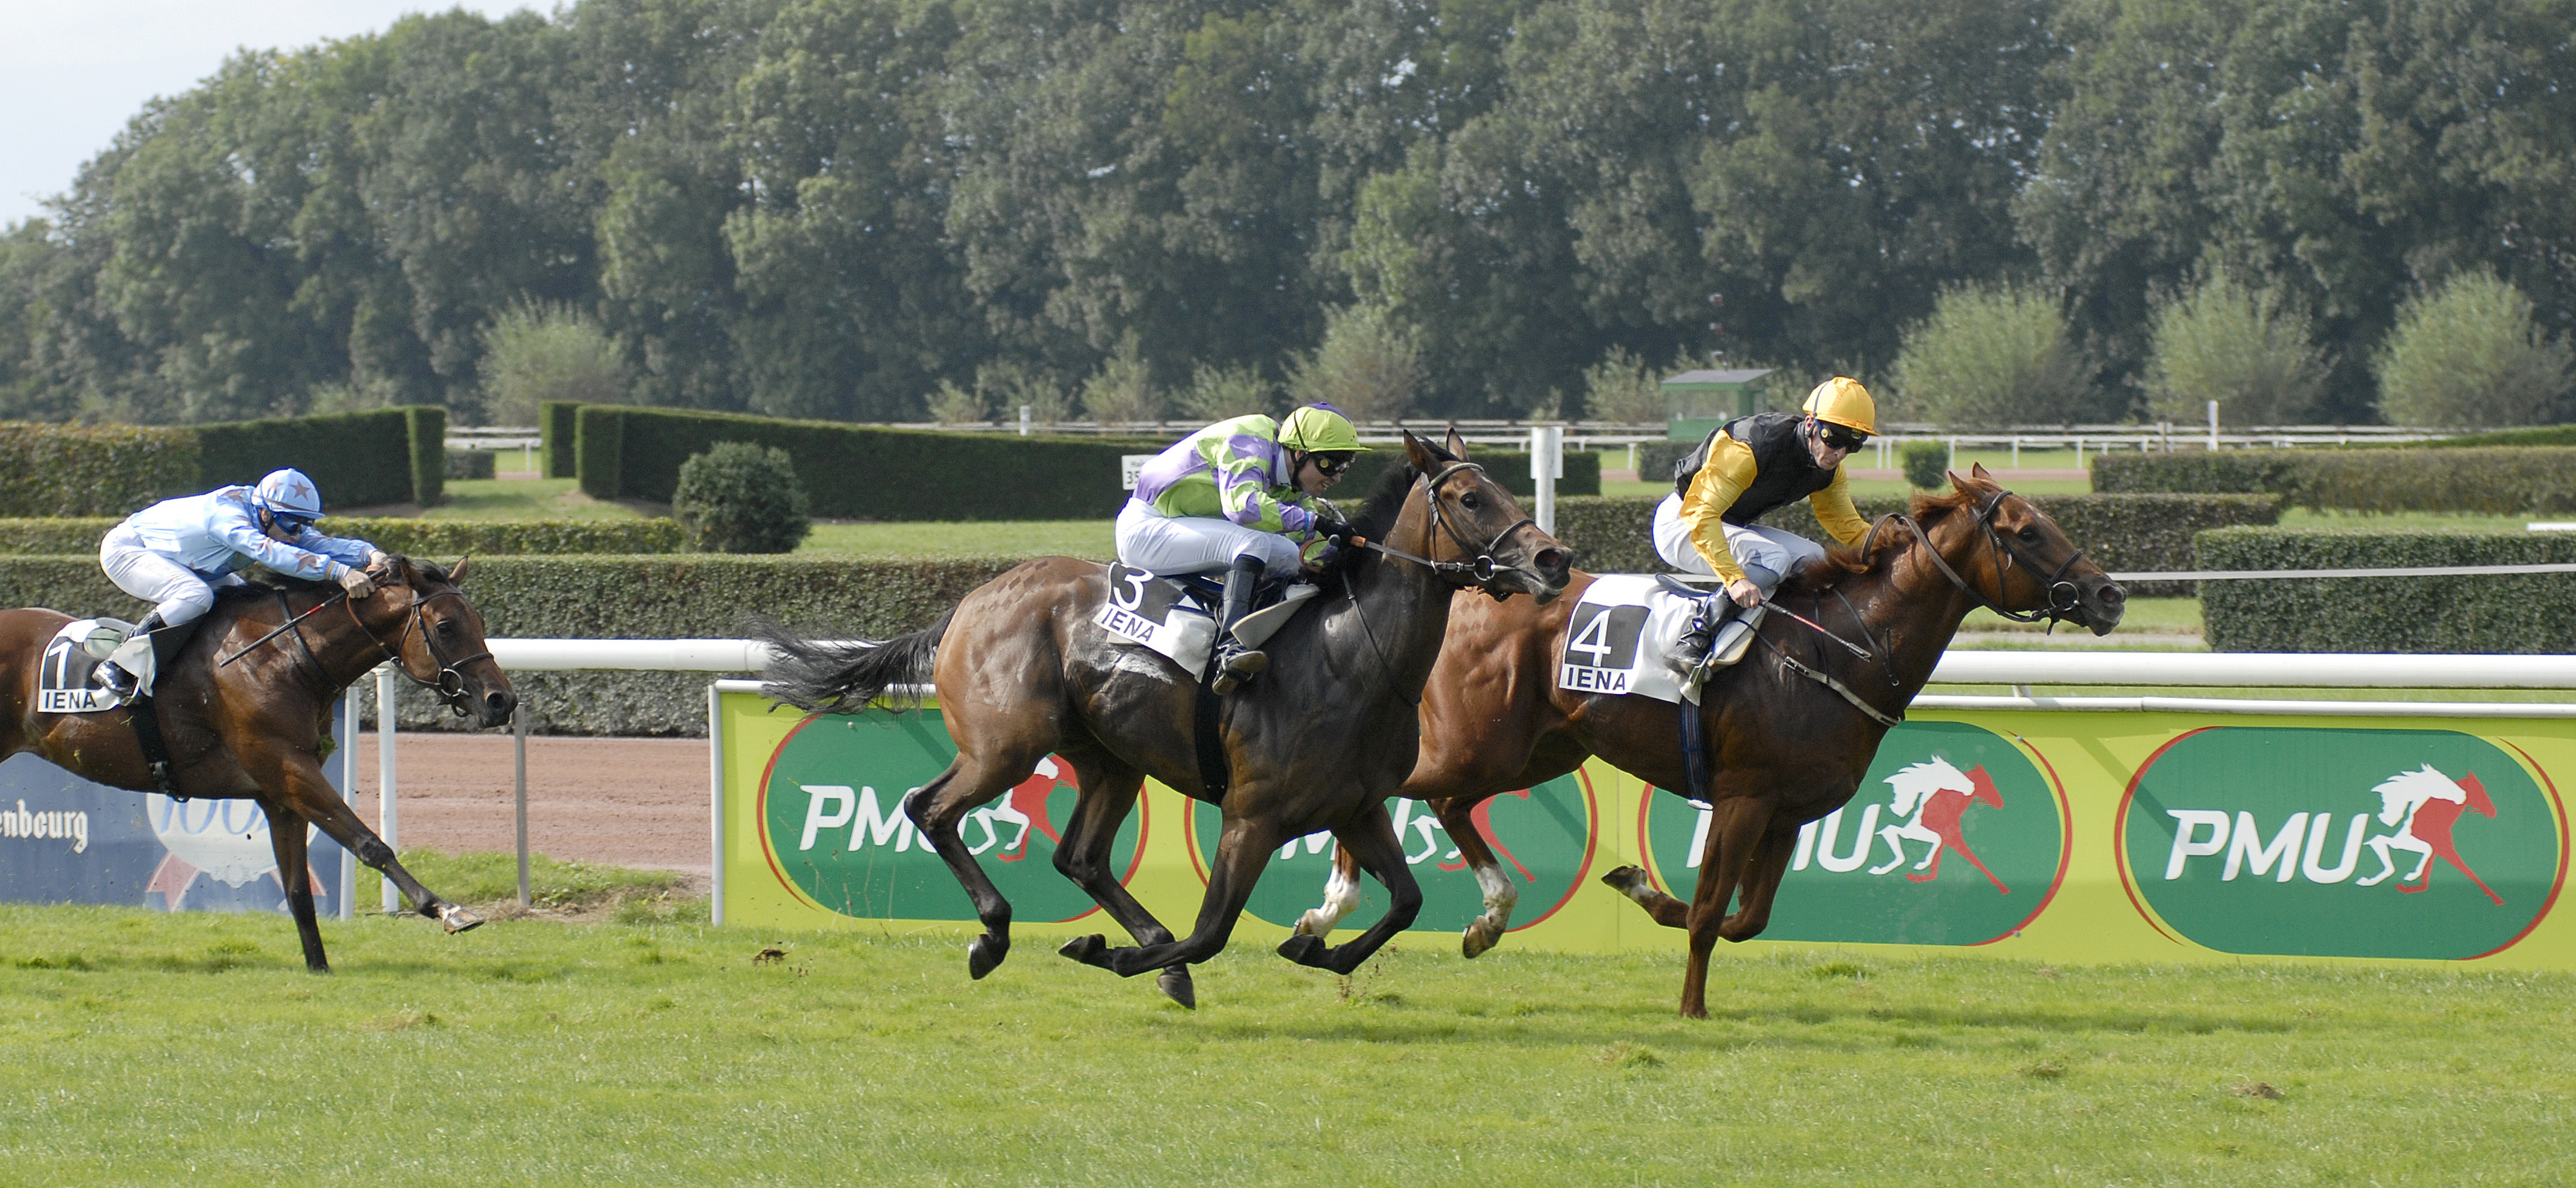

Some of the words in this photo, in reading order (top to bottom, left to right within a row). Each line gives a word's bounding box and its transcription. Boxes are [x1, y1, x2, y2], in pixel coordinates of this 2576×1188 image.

[1114, 563, 1155, 611] 3
[1101, 608, 1155, 642] IENA
[1570, 609, 1612, 667] 4
[48, 641, 74, 690] 1
[1567, 666, 1626, 691] IENA
[45, 691, 97, 710] IENA
[0, 798, 88, 854] nbourg
[799, 785, 969, 854] PM
[2165, 810, 2369, 885] PMU
